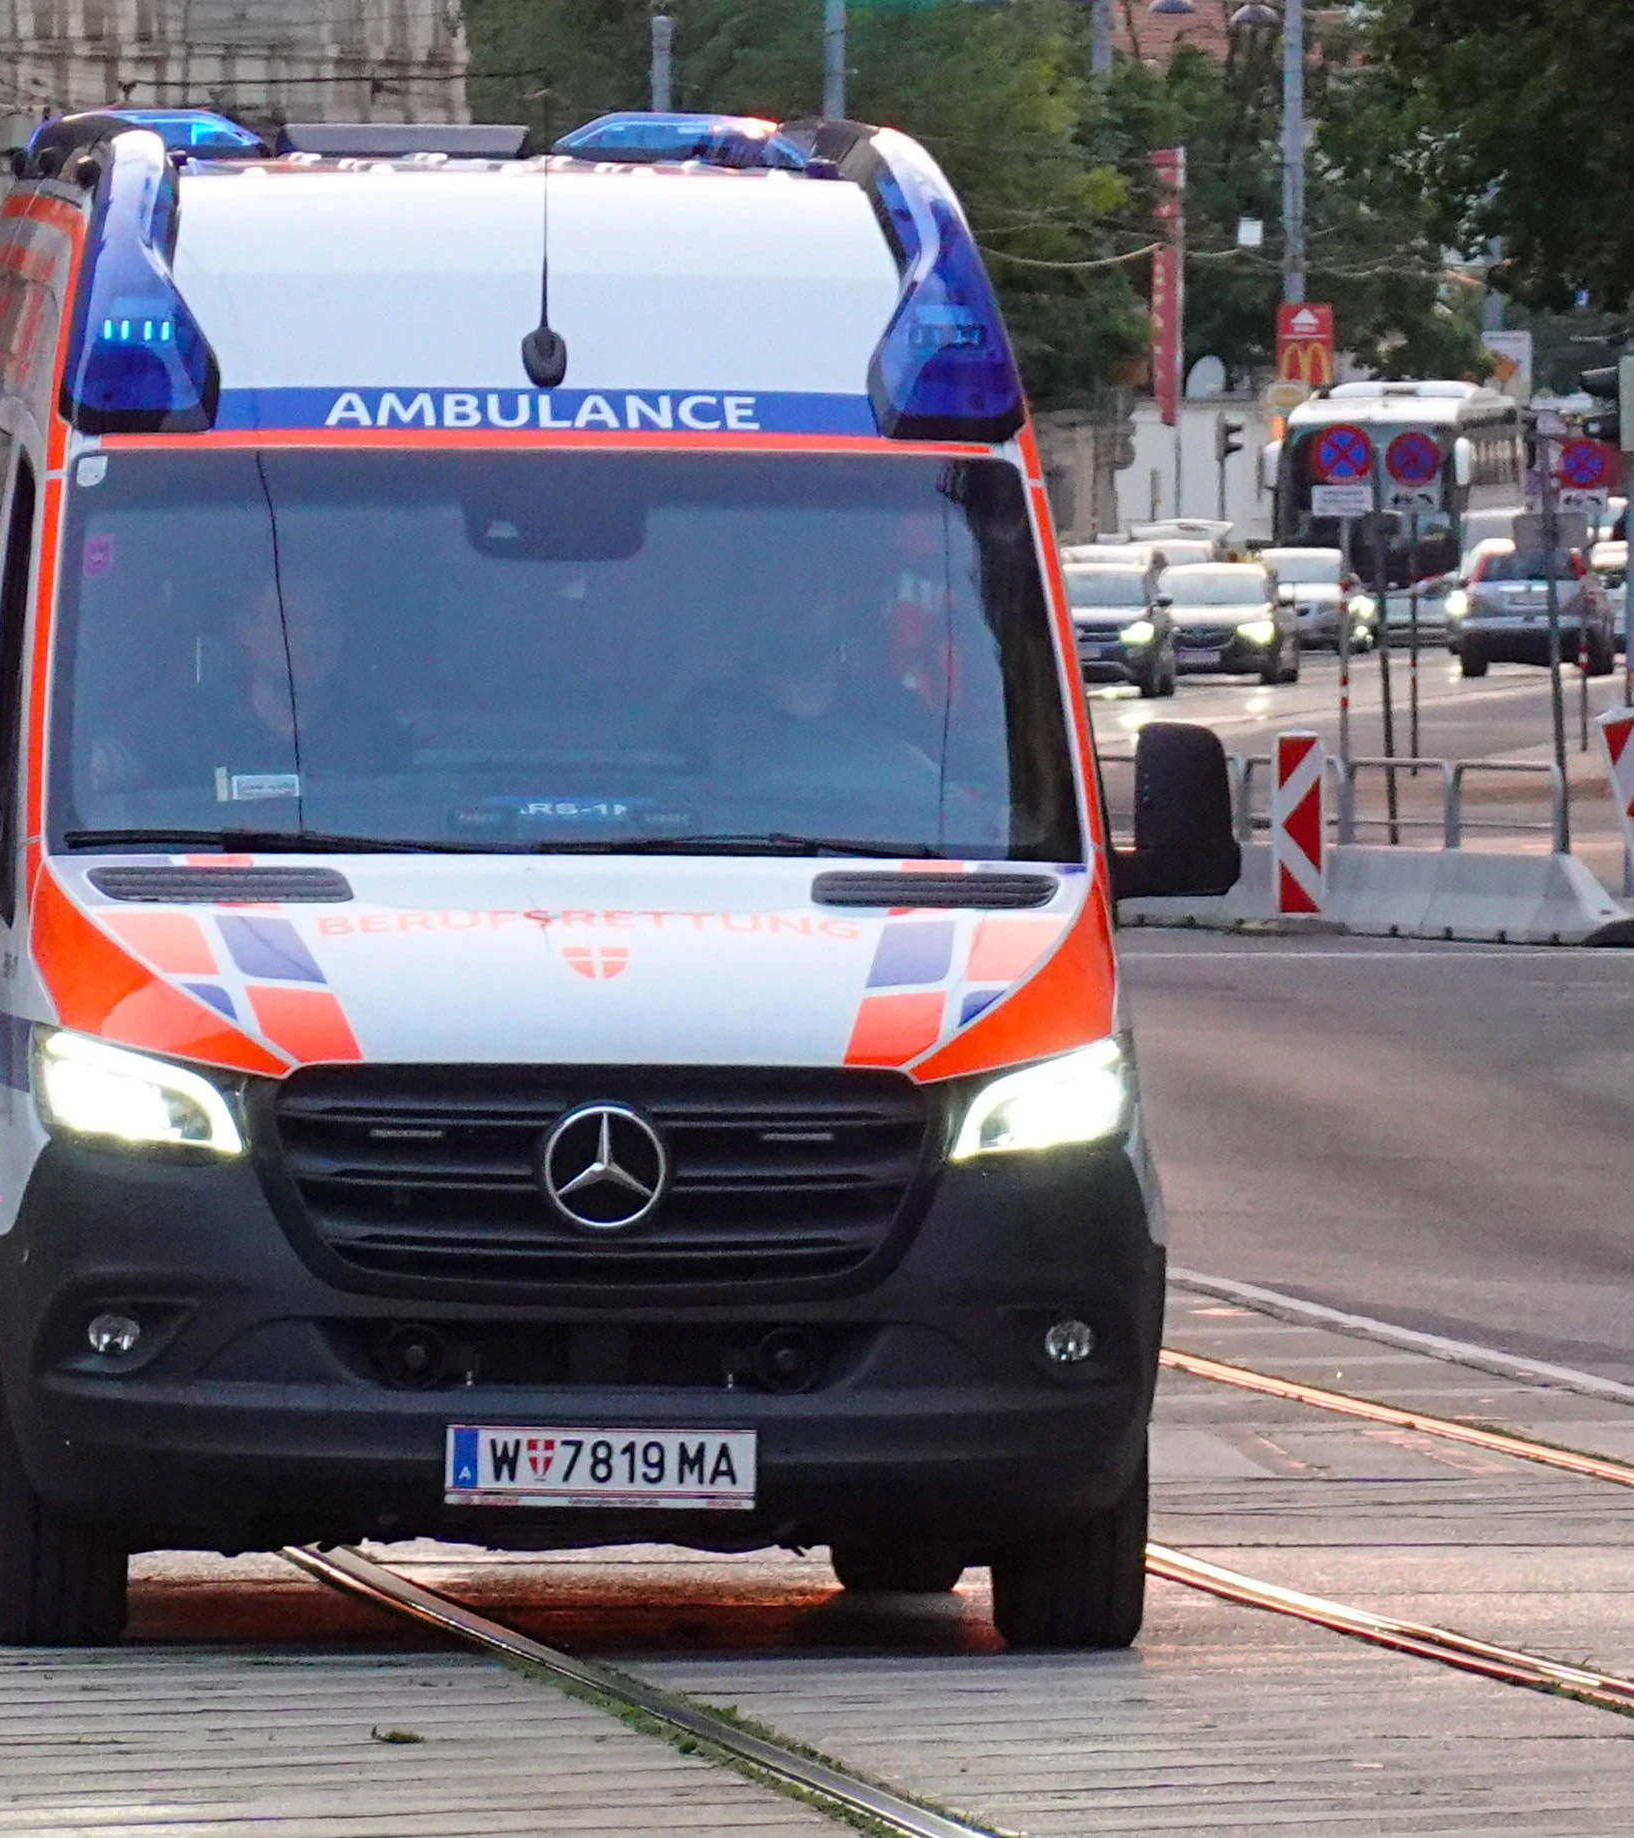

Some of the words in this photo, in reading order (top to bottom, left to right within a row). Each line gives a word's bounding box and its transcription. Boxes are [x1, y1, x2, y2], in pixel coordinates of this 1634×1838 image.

[324, 391, 761, 431] AMBULANCE
[317, 908, 860, 941] BERUFSRETTUNG
[458, 1465, 472, 1481] A
[489, 1438, 520, 1482] W
[560, 1440, 665, 1484] 7819
[677, 1441, 737, 1486] MA
